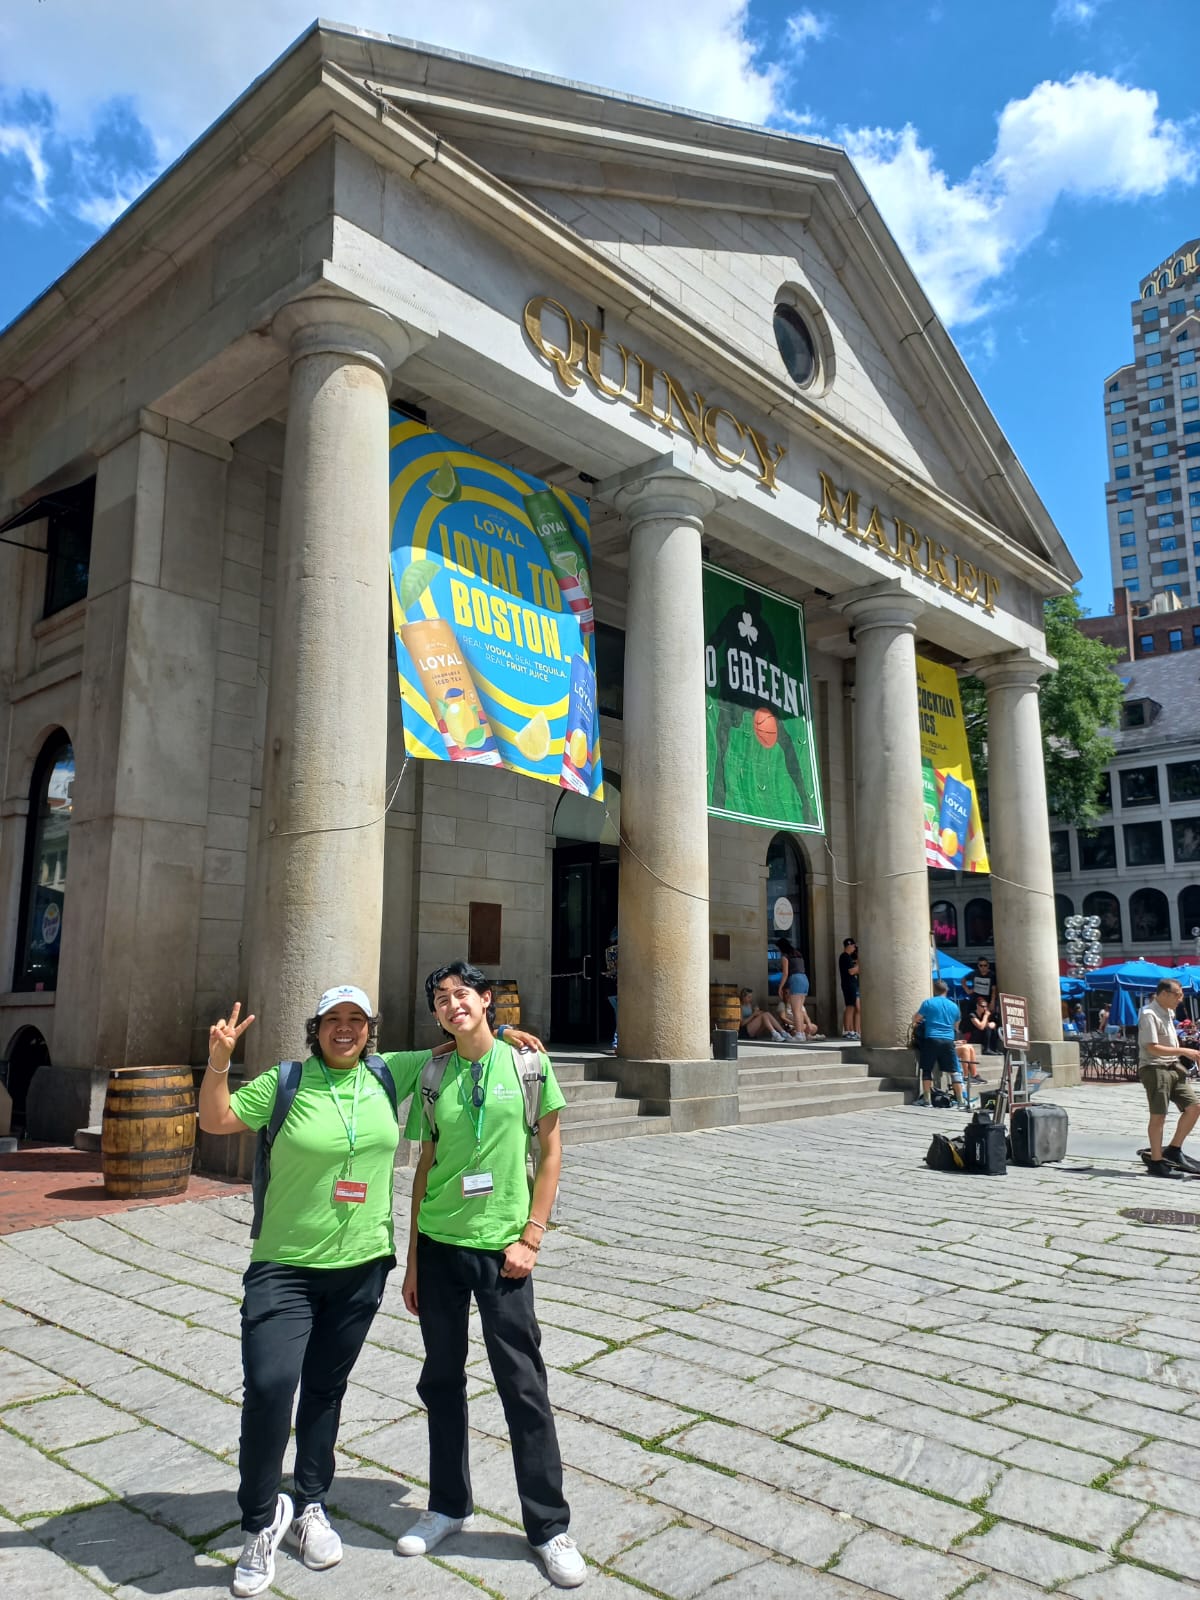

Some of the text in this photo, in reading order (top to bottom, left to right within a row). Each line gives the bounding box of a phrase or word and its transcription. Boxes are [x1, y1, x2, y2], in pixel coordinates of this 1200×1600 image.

[524, 296, 1000, 615] QUINCY MARKET
[474, 514, 525, 548] LOYAL
[536, 521, 567, 537] LOYAL
[439, 523, 563, 613] LOYAL TO
[450, 578, 572, 664] BOSTON.
[418, 652, 463, 672] LOYAL
[506, 661, 528, 674] FRUIT
[574, 681, 593, 713] LOYAL
[944, 794, 968, 818] LOYAL
